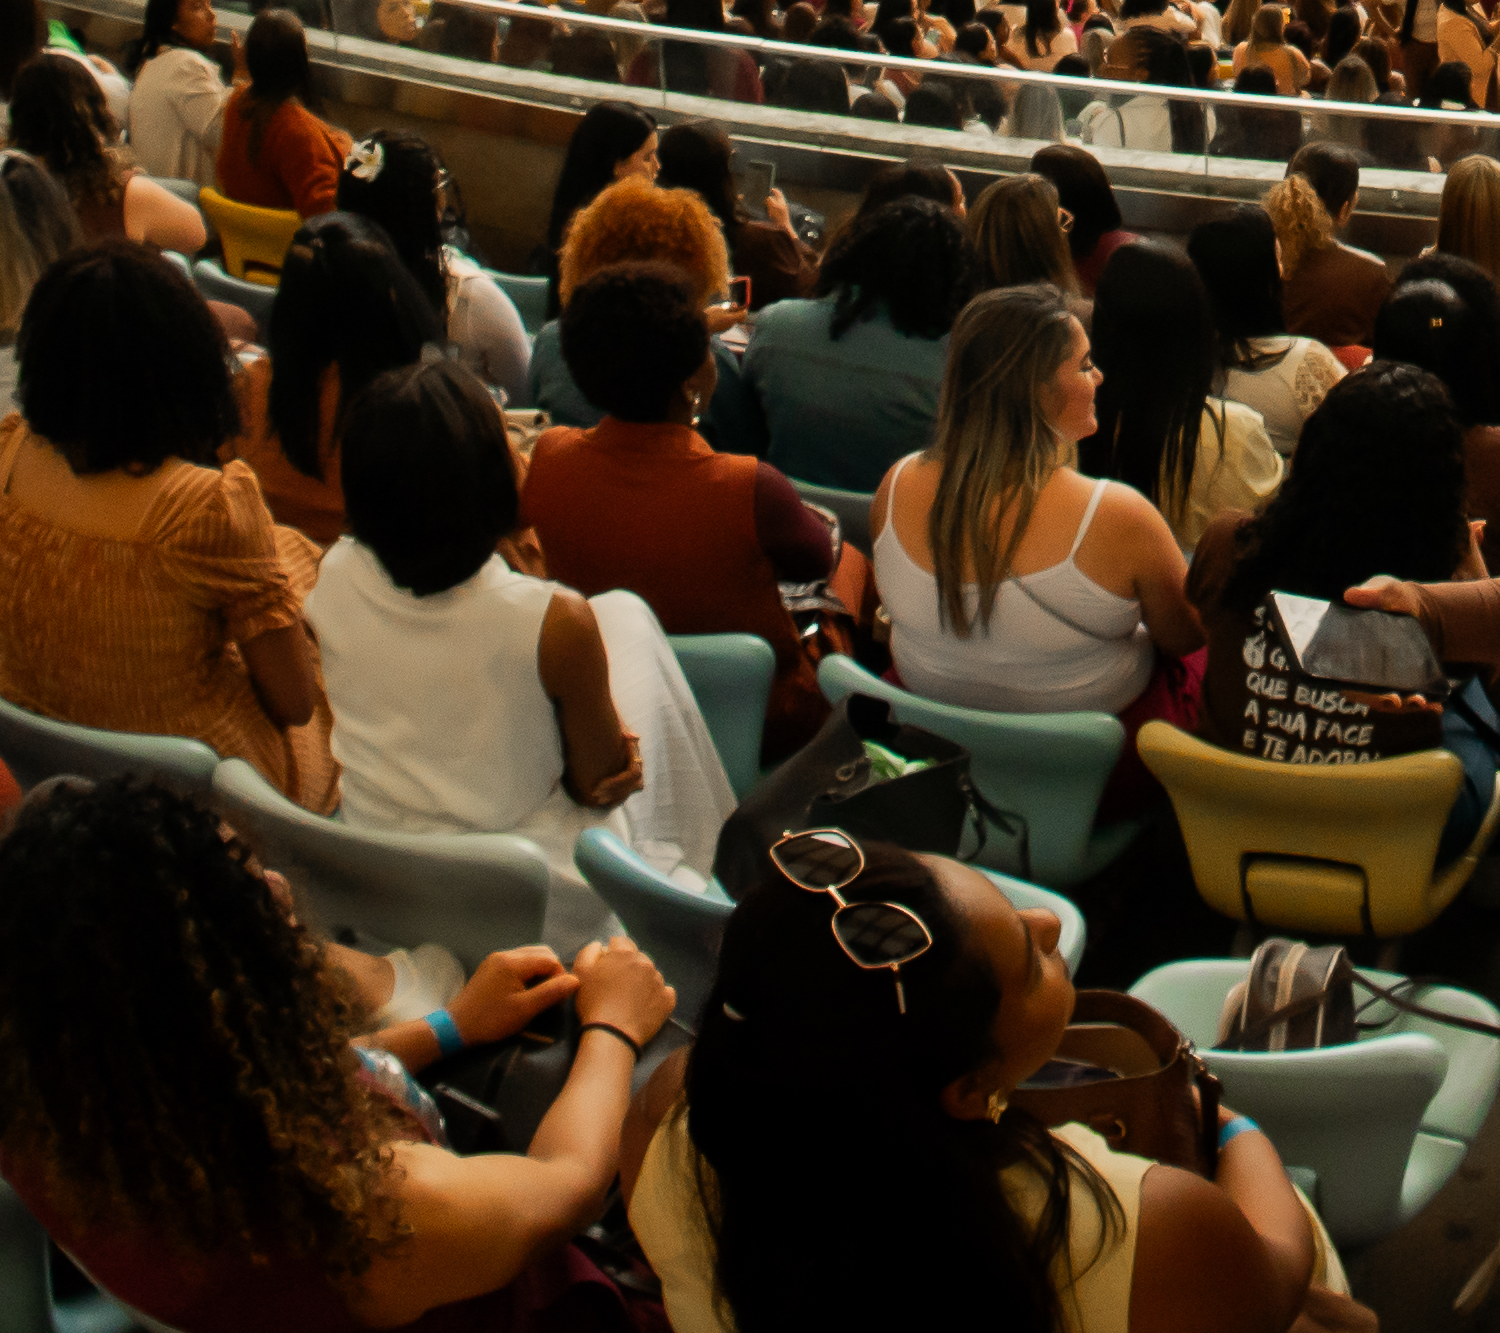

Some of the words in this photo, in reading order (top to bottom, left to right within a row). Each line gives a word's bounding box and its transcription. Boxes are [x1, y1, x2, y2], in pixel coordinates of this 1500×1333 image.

[1245, 671, 1289, 700] QUE
[1244, 699, 1260, 725] A
[1267, 708, 1308, 741] SUA
[1313, 717, 1375, 746] FACE
[1242, 728, 1257, 749] E
[1262, 732, 1288, 761] TE
